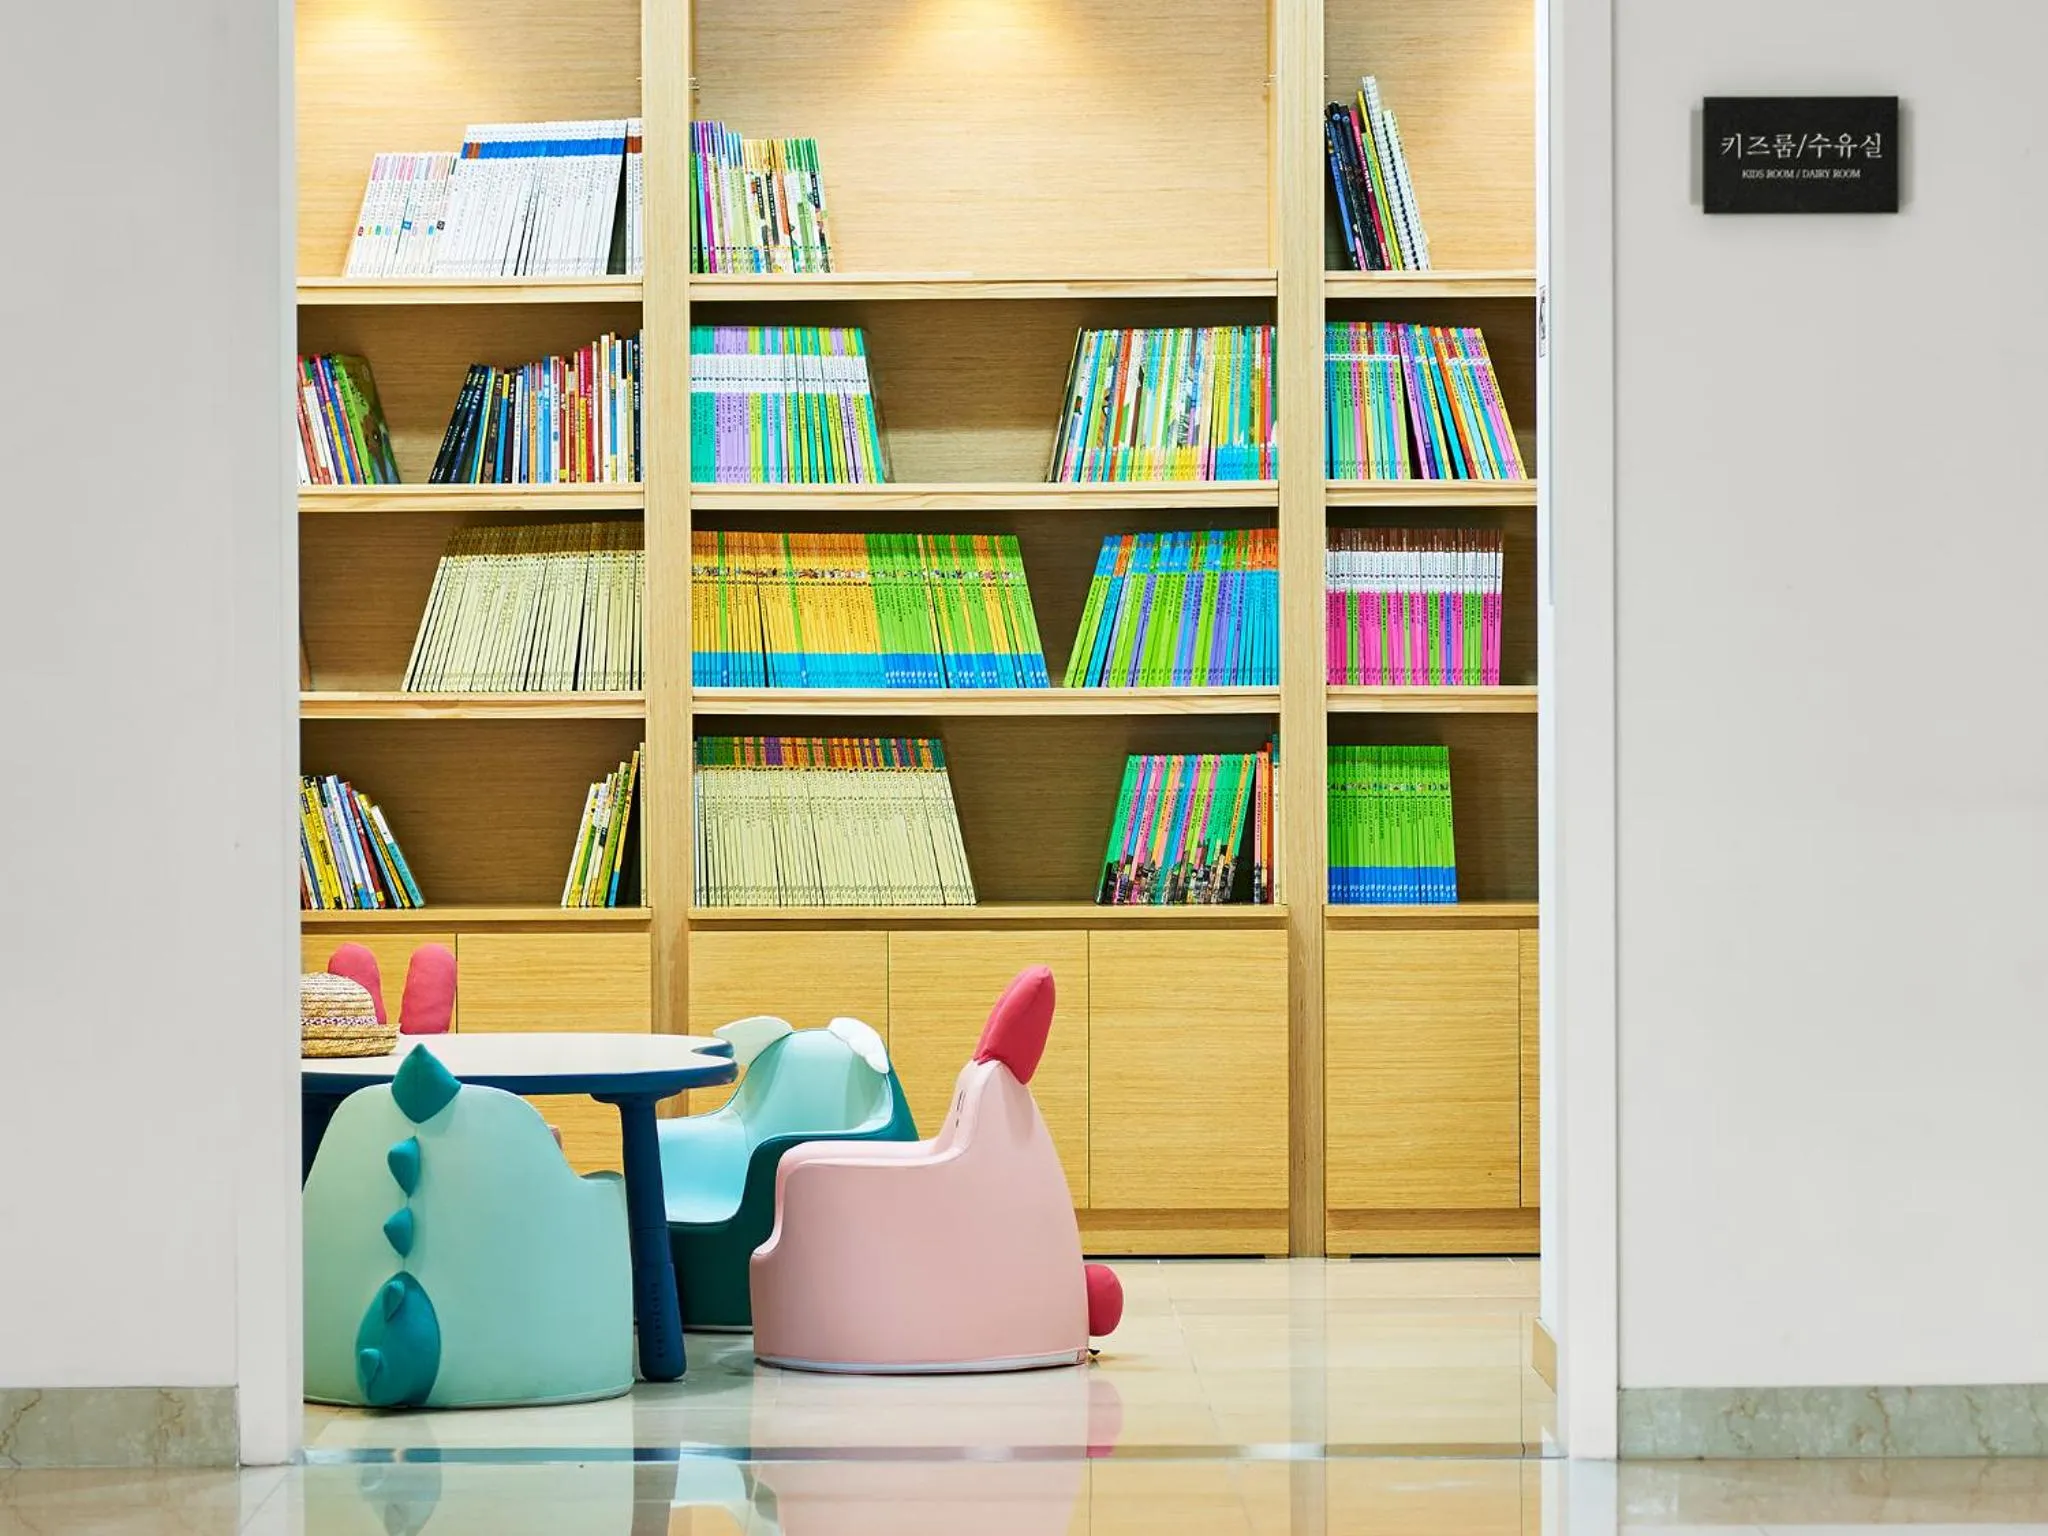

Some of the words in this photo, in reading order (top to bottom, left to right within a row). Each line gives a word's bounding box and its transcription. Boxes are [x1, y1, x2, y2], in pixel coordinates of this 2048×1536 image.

[1721, 132, 1883, 159] 키즈룸/수유실
[1742, 169, 1765, 179] KIDS
[1766, 169, 1795, 179] ROOM
[1802, 169, 1831, 179] DAIRY
[1833, 169, 1861, 179] ROOM
